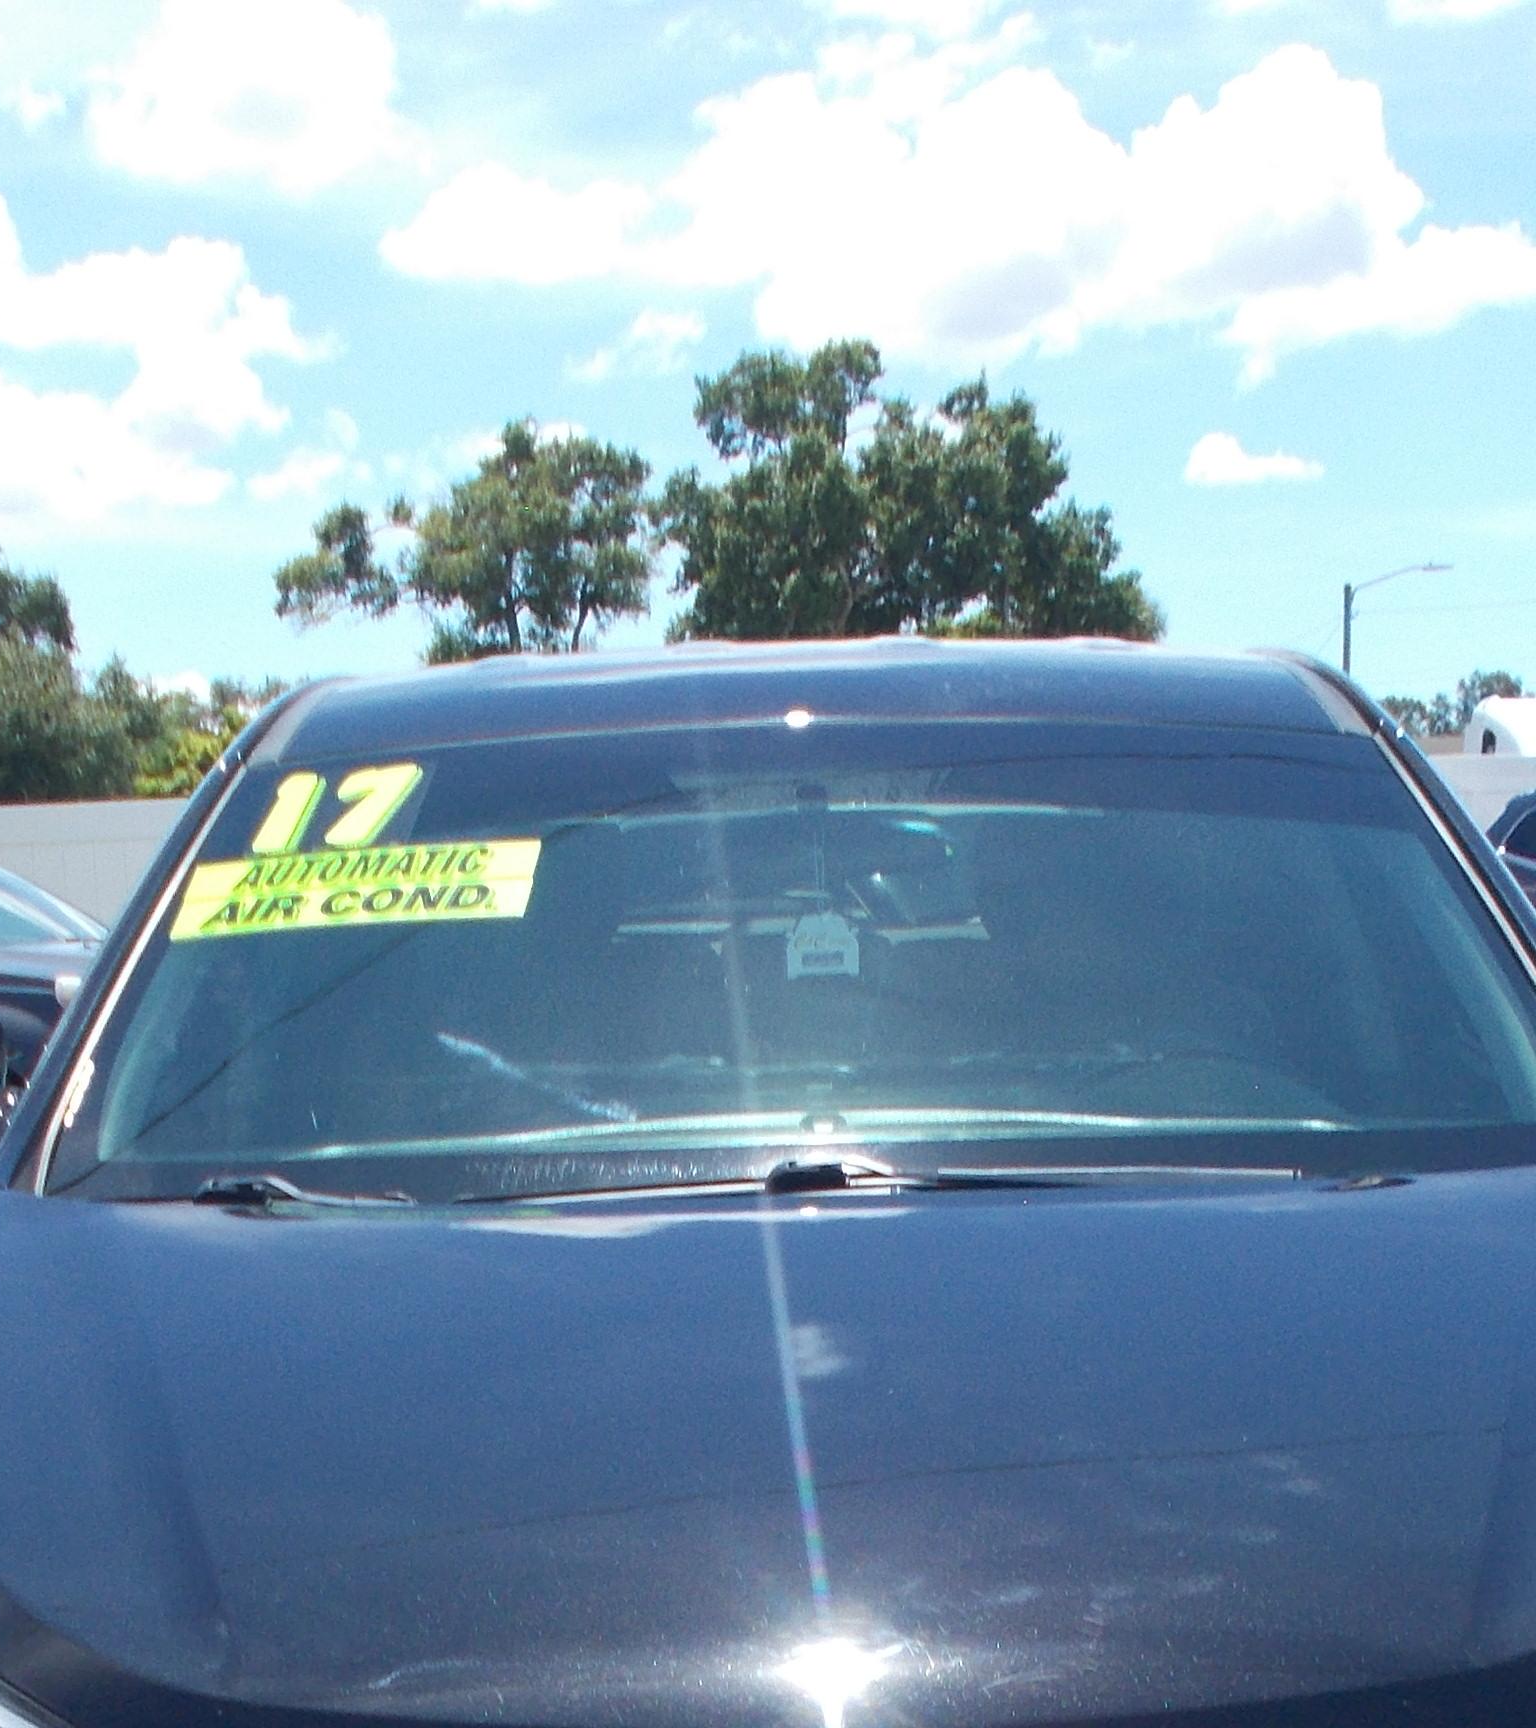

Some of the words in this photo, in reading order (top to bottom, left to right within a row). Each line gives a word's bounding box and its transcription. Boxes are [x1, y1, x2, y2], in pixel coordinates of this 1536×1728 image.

[251, 761, 424, 854] 17
[232, 843, 492, 895] AUTOMATIC
[200, 892, 307, 932] AIR
